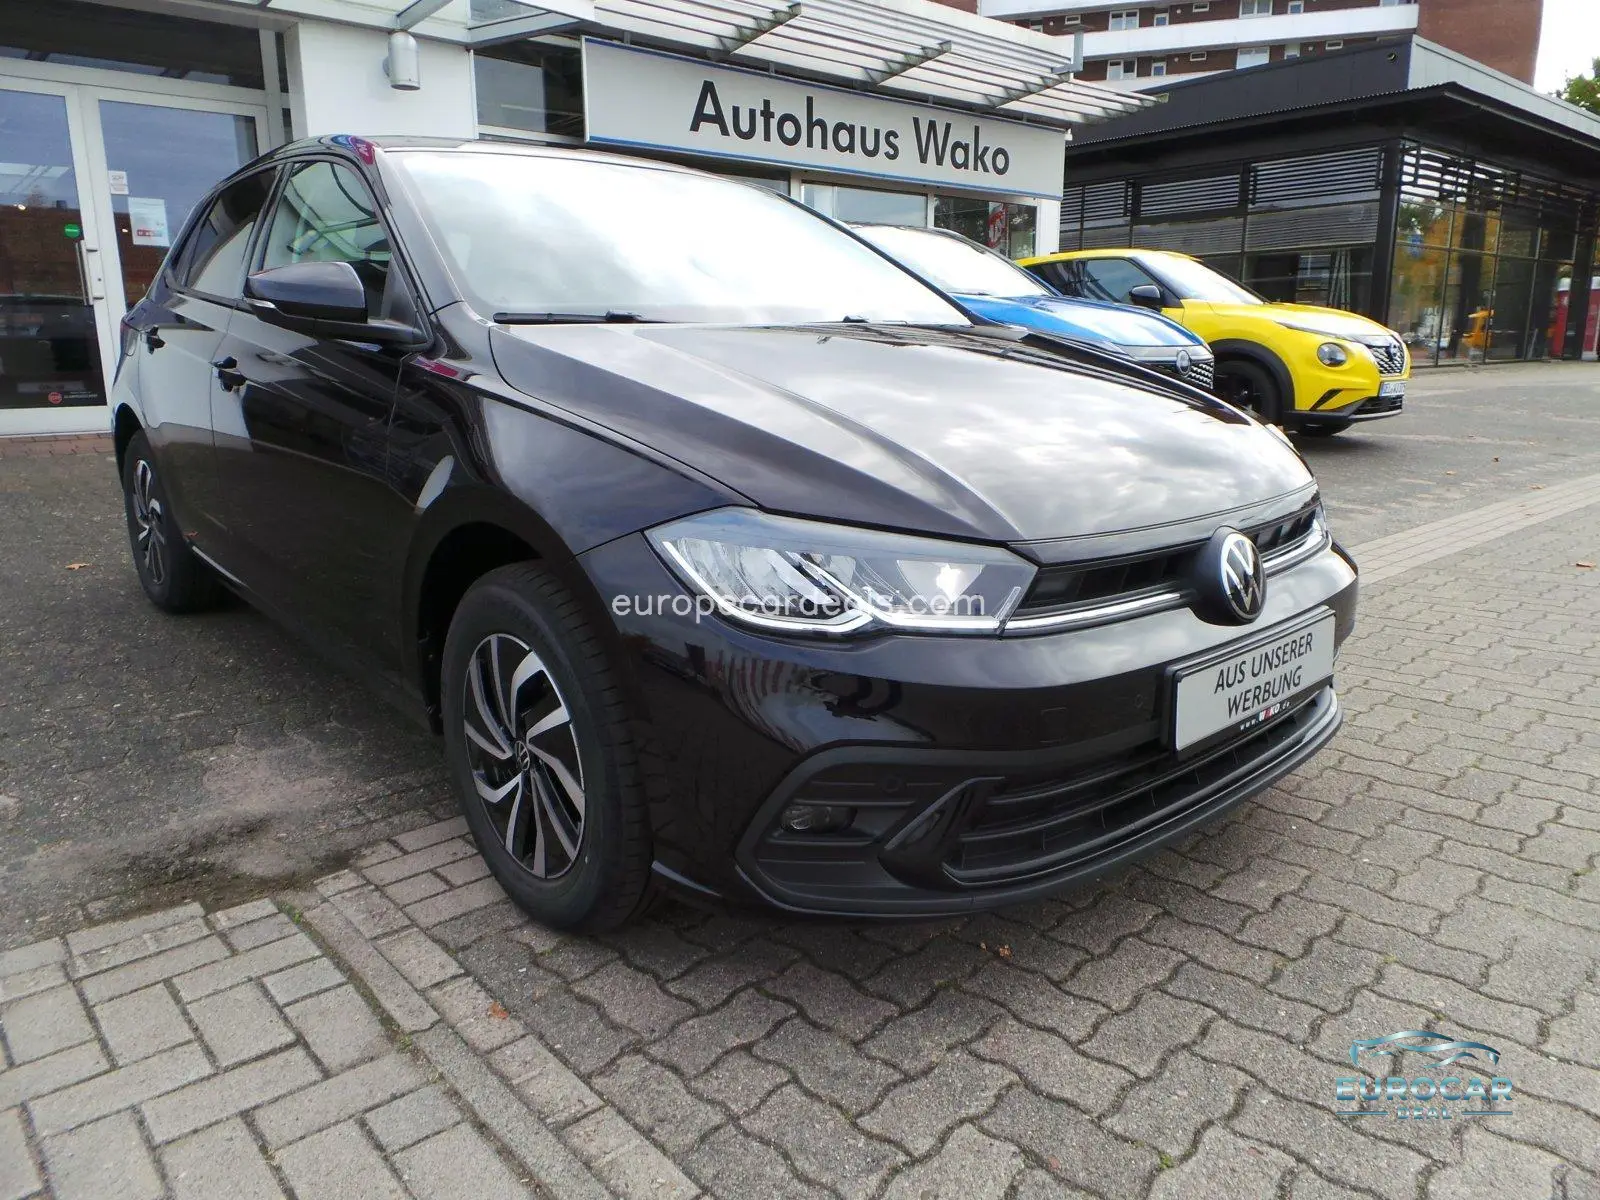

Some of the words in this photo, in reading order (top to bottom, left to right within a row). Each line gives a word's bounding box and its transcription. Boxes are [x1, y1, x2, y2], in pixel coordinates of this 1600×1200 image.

[690, 80, 900, 161] Autohaus
[912, 116, 1010, 176] Wako
[1214, 660, 1246, 694] AUS
[1251, 632, 1313, 678] UNSERER
[1228, 666, 1302, 719] WERBUNG
